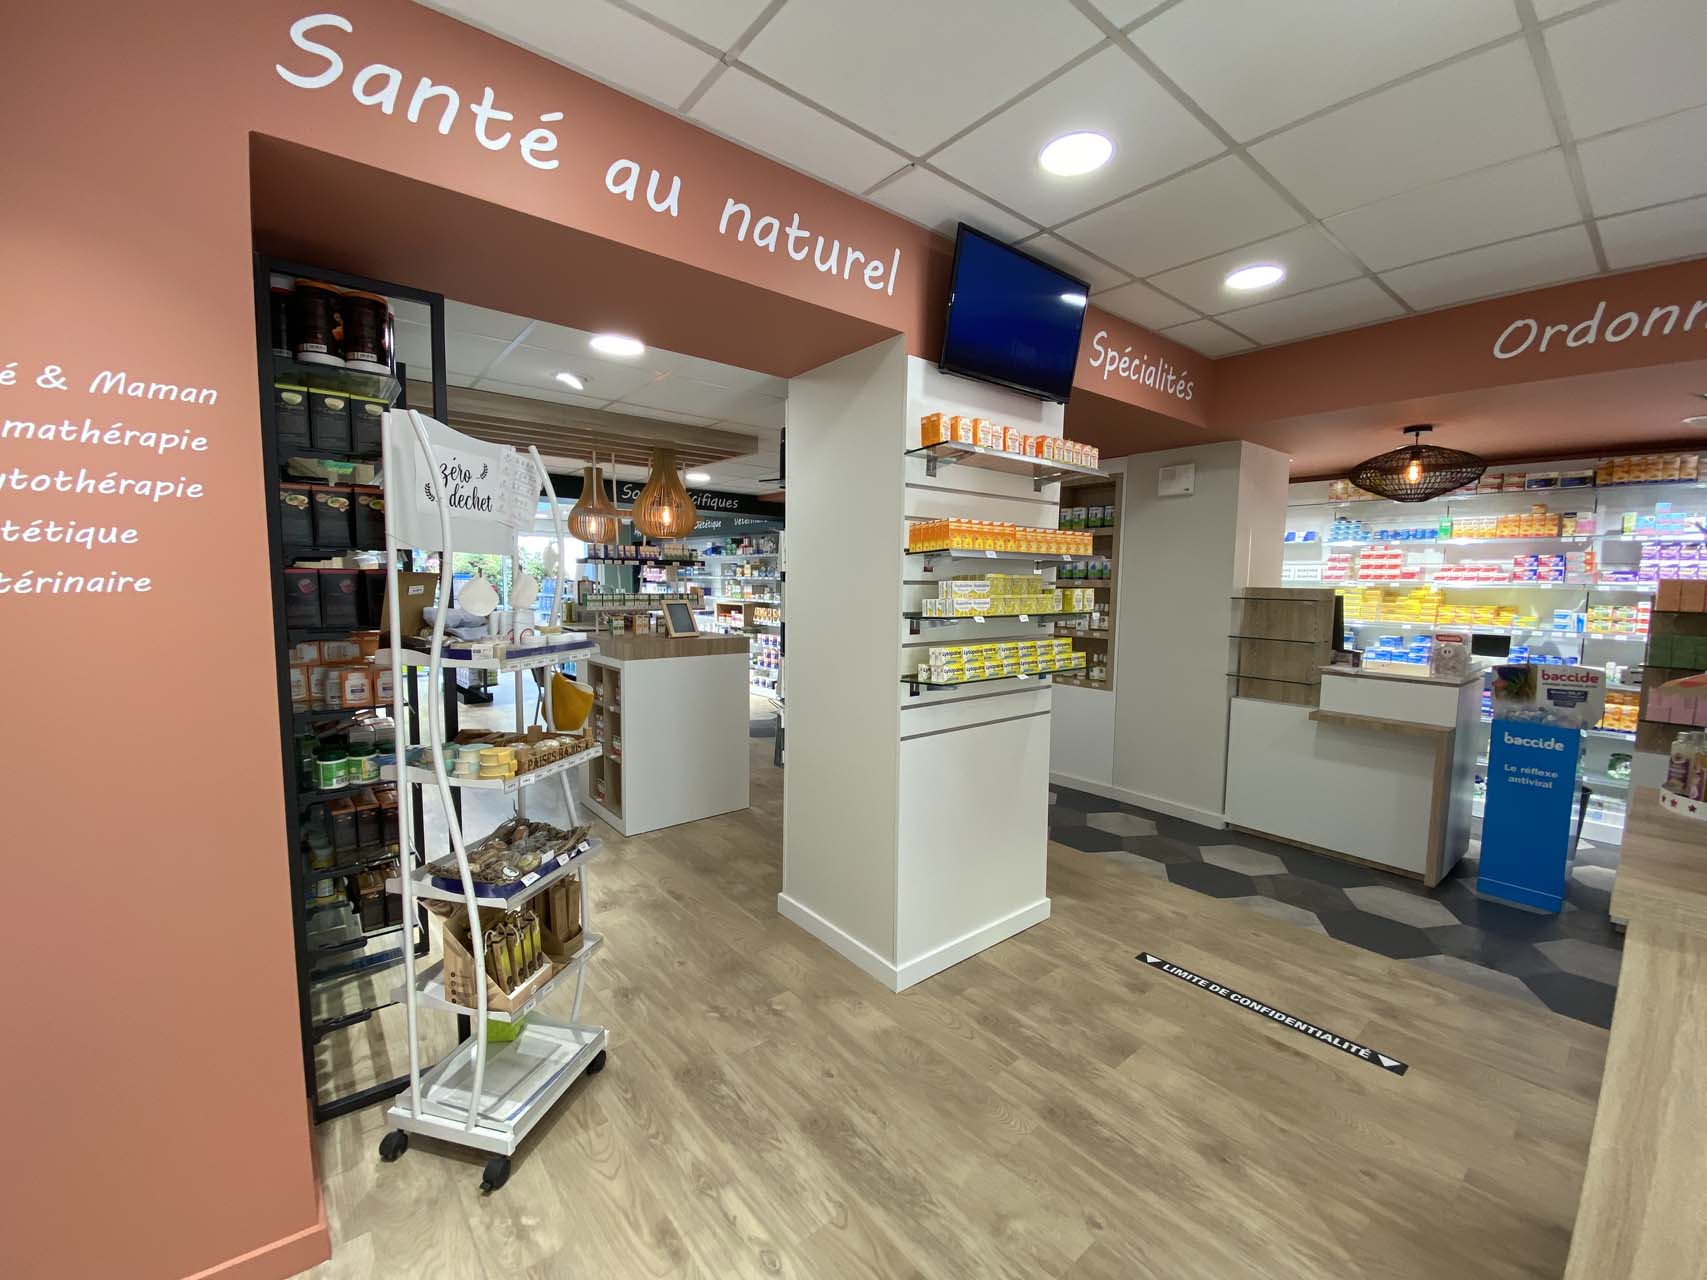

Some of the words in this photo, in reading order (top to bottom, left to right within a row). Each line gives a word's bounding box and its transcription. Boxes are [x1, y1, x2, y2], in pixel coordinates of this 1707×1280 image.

[276, 13, 564, 170] Santé
[605, 158, 682, 217] au
[718, 197, 901, 297] naturel
[1089, 330, 1195, 402] Spécialités
[36, 364, 68, 391] &
[89, 370, 218, 405] Maman
[1, 418, 209, 455] mathérapie
[440, 456, 473, 488] zéro
[449, 484, 493, 513] déchet
[688, 491, 740, 511] cifiques
[0, 519, 139, 550] tétique
[1541, 669, 1599, 684] baccide
[1504, 731, 1564, 751] baccide
[1504, 763, 1517, 772] Le
[1520, 765, 1559, 779] réflexe
[1507, 775, 1553, 789] antiviral
[1162, 963, 1208, 988] LIMITE
[1208, 983, 1230, 997] DE
[1229, 993, 1372, 1060] CONFIDENTIALITÉ
